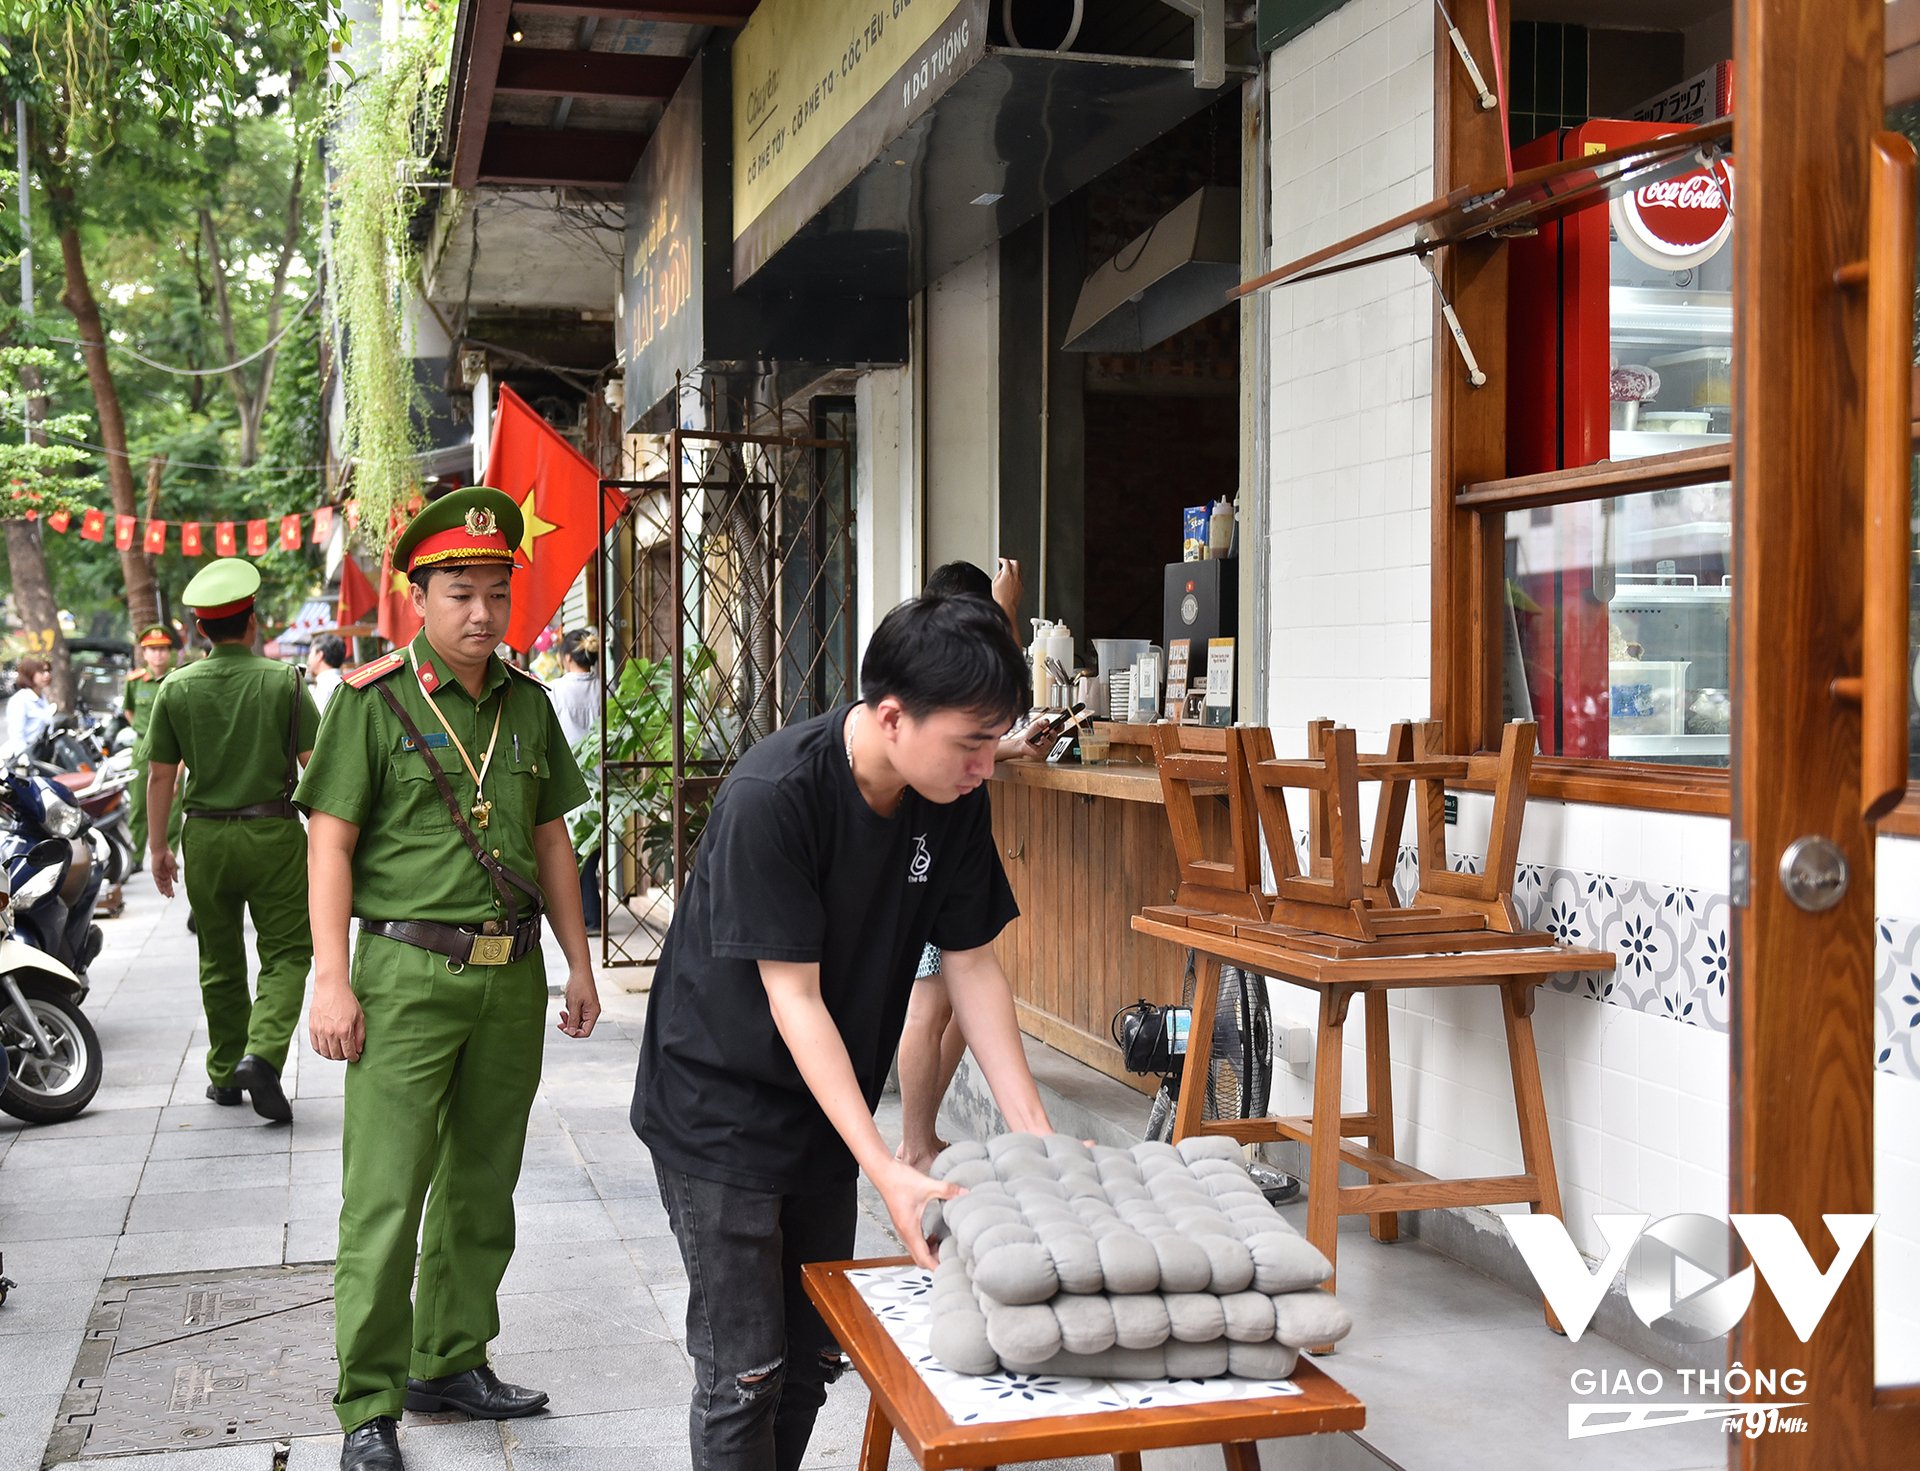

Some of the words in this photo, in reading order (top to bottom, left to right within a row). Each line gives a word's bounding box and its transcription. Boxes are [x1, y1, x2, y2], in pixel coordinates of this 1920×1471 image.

[902, 80, 911, 109] 11
[931, 19, 969, 80] TƯỢNG
[1637, 175, 1727, 209] Coca-Cola
